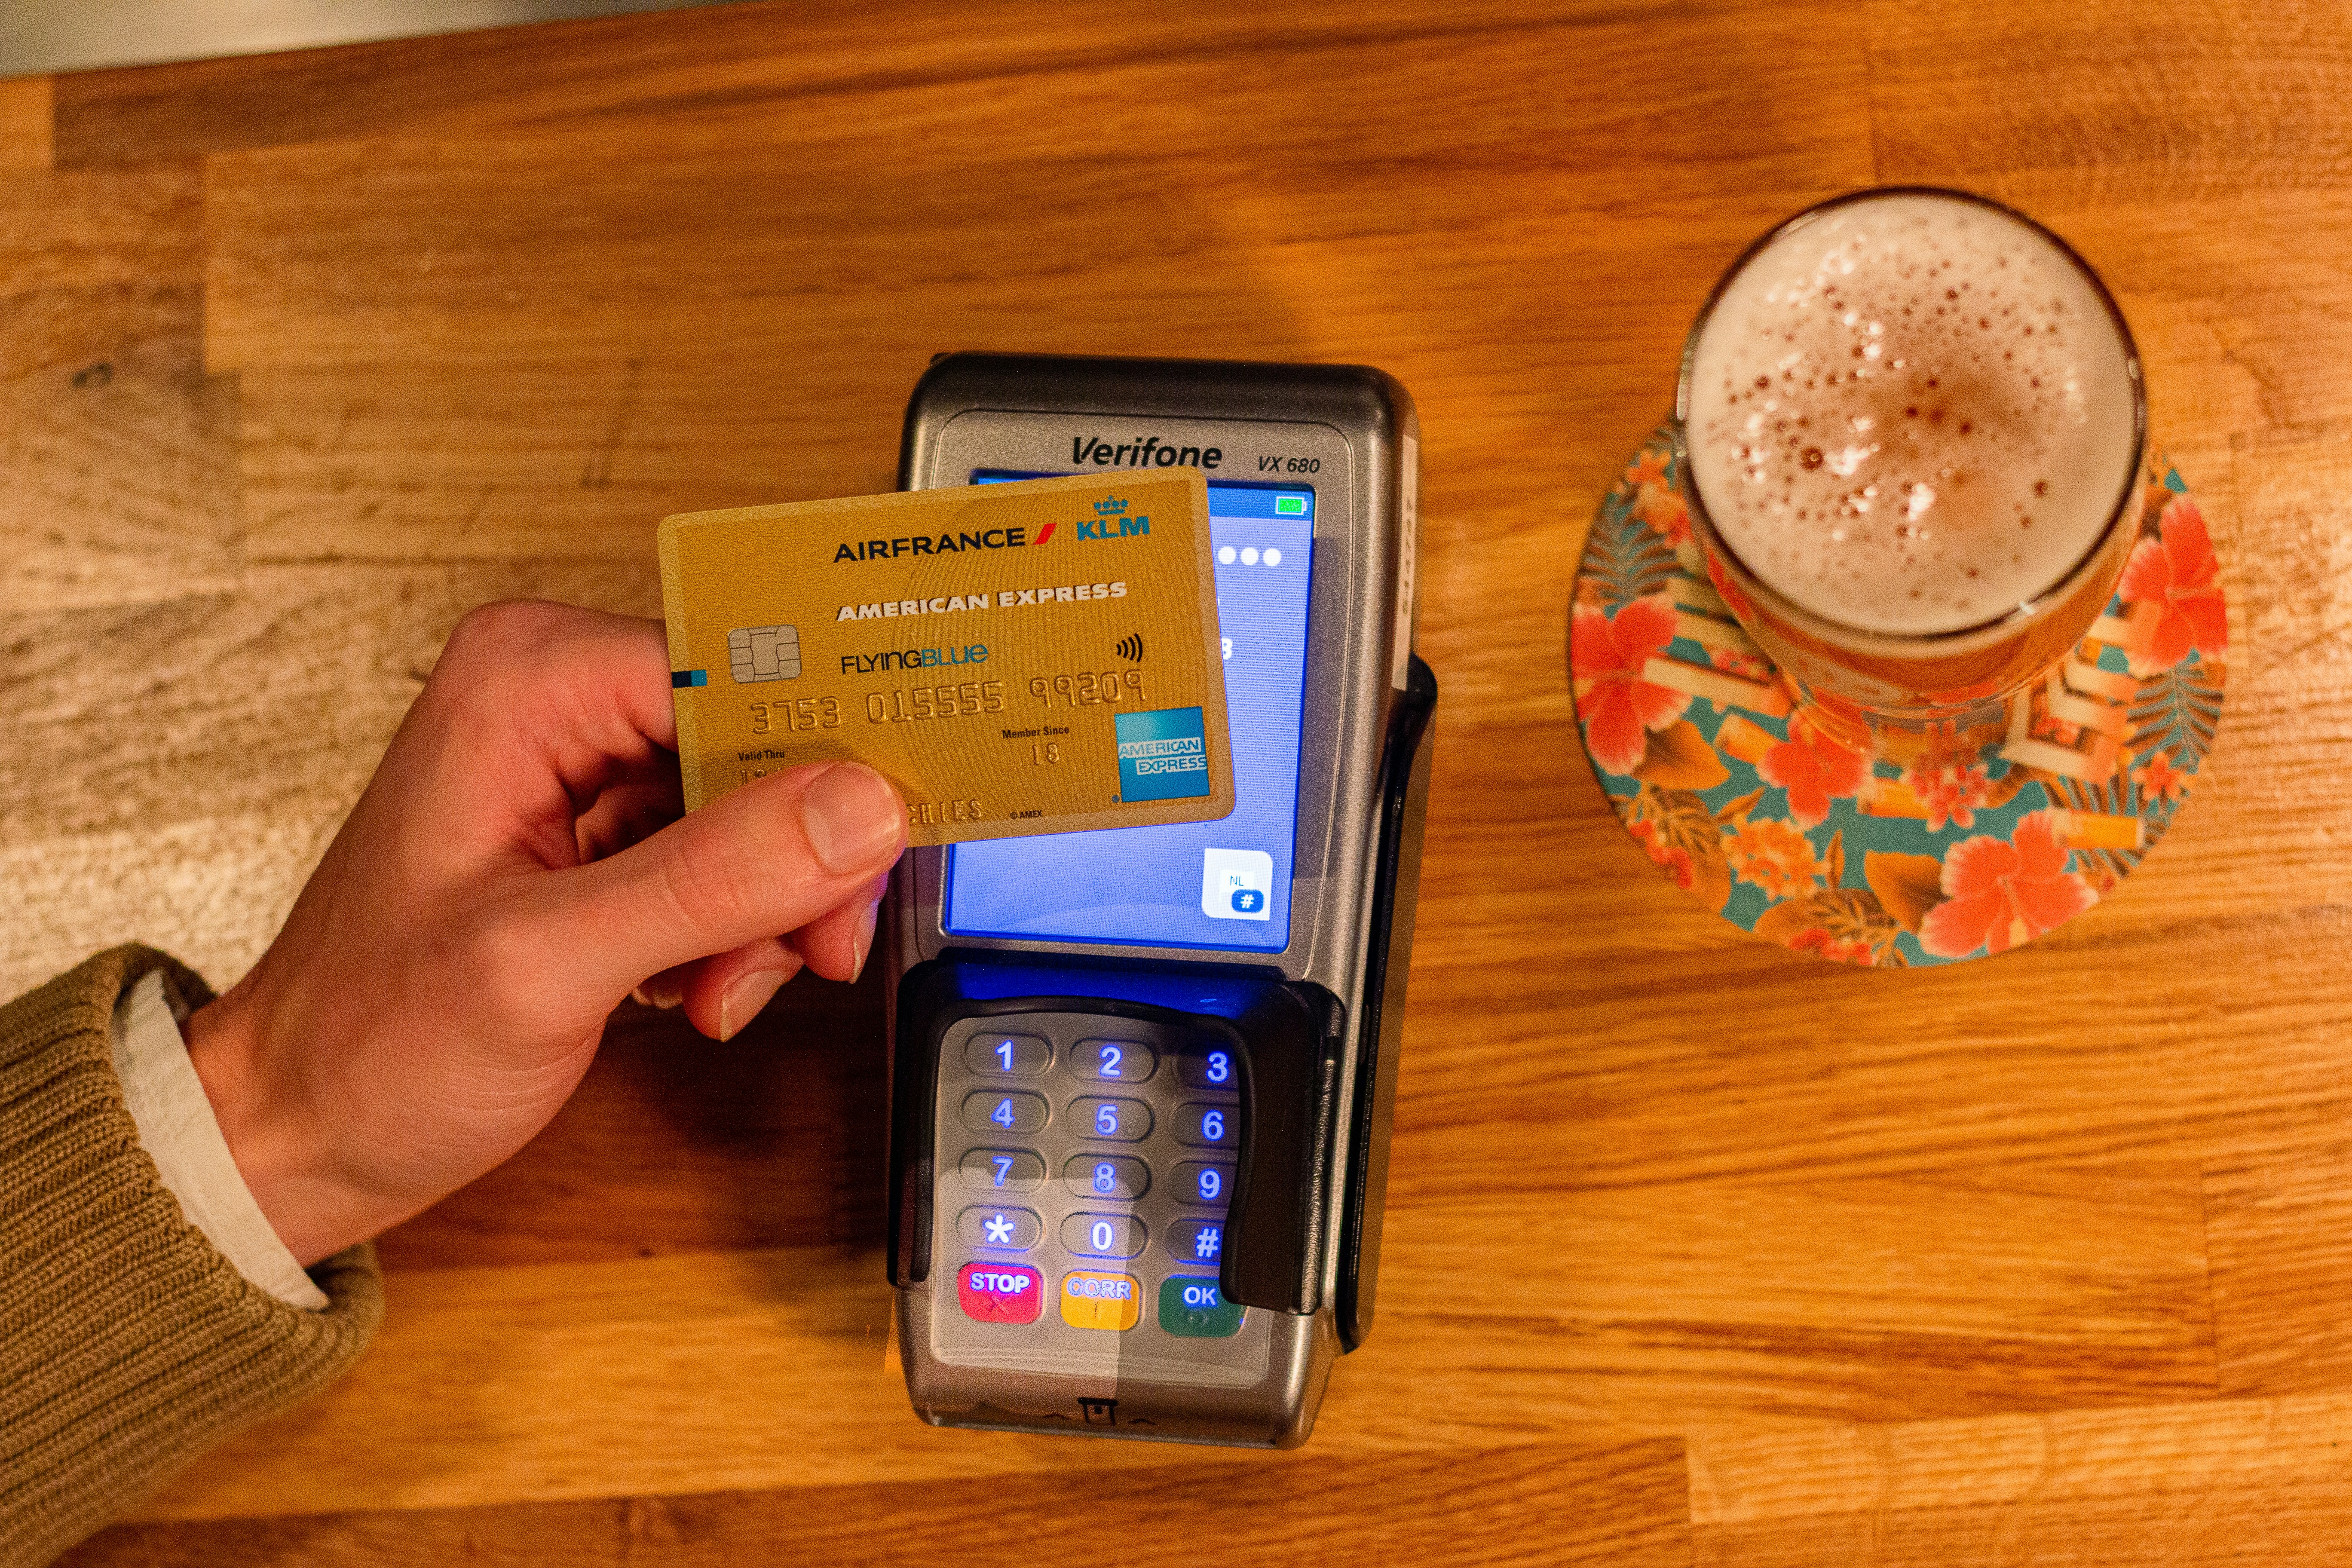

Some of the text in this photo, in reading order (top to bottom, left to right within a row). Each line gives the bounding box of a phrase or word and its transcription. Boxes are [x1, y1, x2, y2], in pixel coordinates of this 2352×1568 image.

[1072, 436, 1223, 469] Verifone
[1259, 456, 1321, 474] VX 680
[1077, 516, 1150, 541] KLM
[833, 527, 1026, 563] AIRFRANCE
[836, 582, 1127, 621] AMERICAN EXPRESS
[751, 669, 1146, 734] 3753 015555 99209
[1002, 726, 1069, 739] Member Since
[738, 750, 784, 761] Valid Thru
[1118, 738, 1207, 773] AMERICAN EXPRESS
[1230, 875, 1244, 886] NL
[995, 1040, 1013, 1071] 1
[1098, 1046, 1122, 1078] 2
[1207, 1051, 1228, 1082] 3
[992, 1098, 1015, 1128] 4
[1096, 1104, 1118, 1135] 5
[1203, 1110, 1224, 1141] 6
[992, 1156, 1014, 1186] 7
[1094, 1163, 1116, 1193] 8
[1199, 1169, 1222, 1200] 9
[1091, 1222, 1113, 1251] 0
[1196, 1228, 1219, 1258] #
[970, 1273, 1030, 1294] STOP
[1067, 1278, 1131, 1299] CORR
[1183, 1286, 1217, 1307] OK
